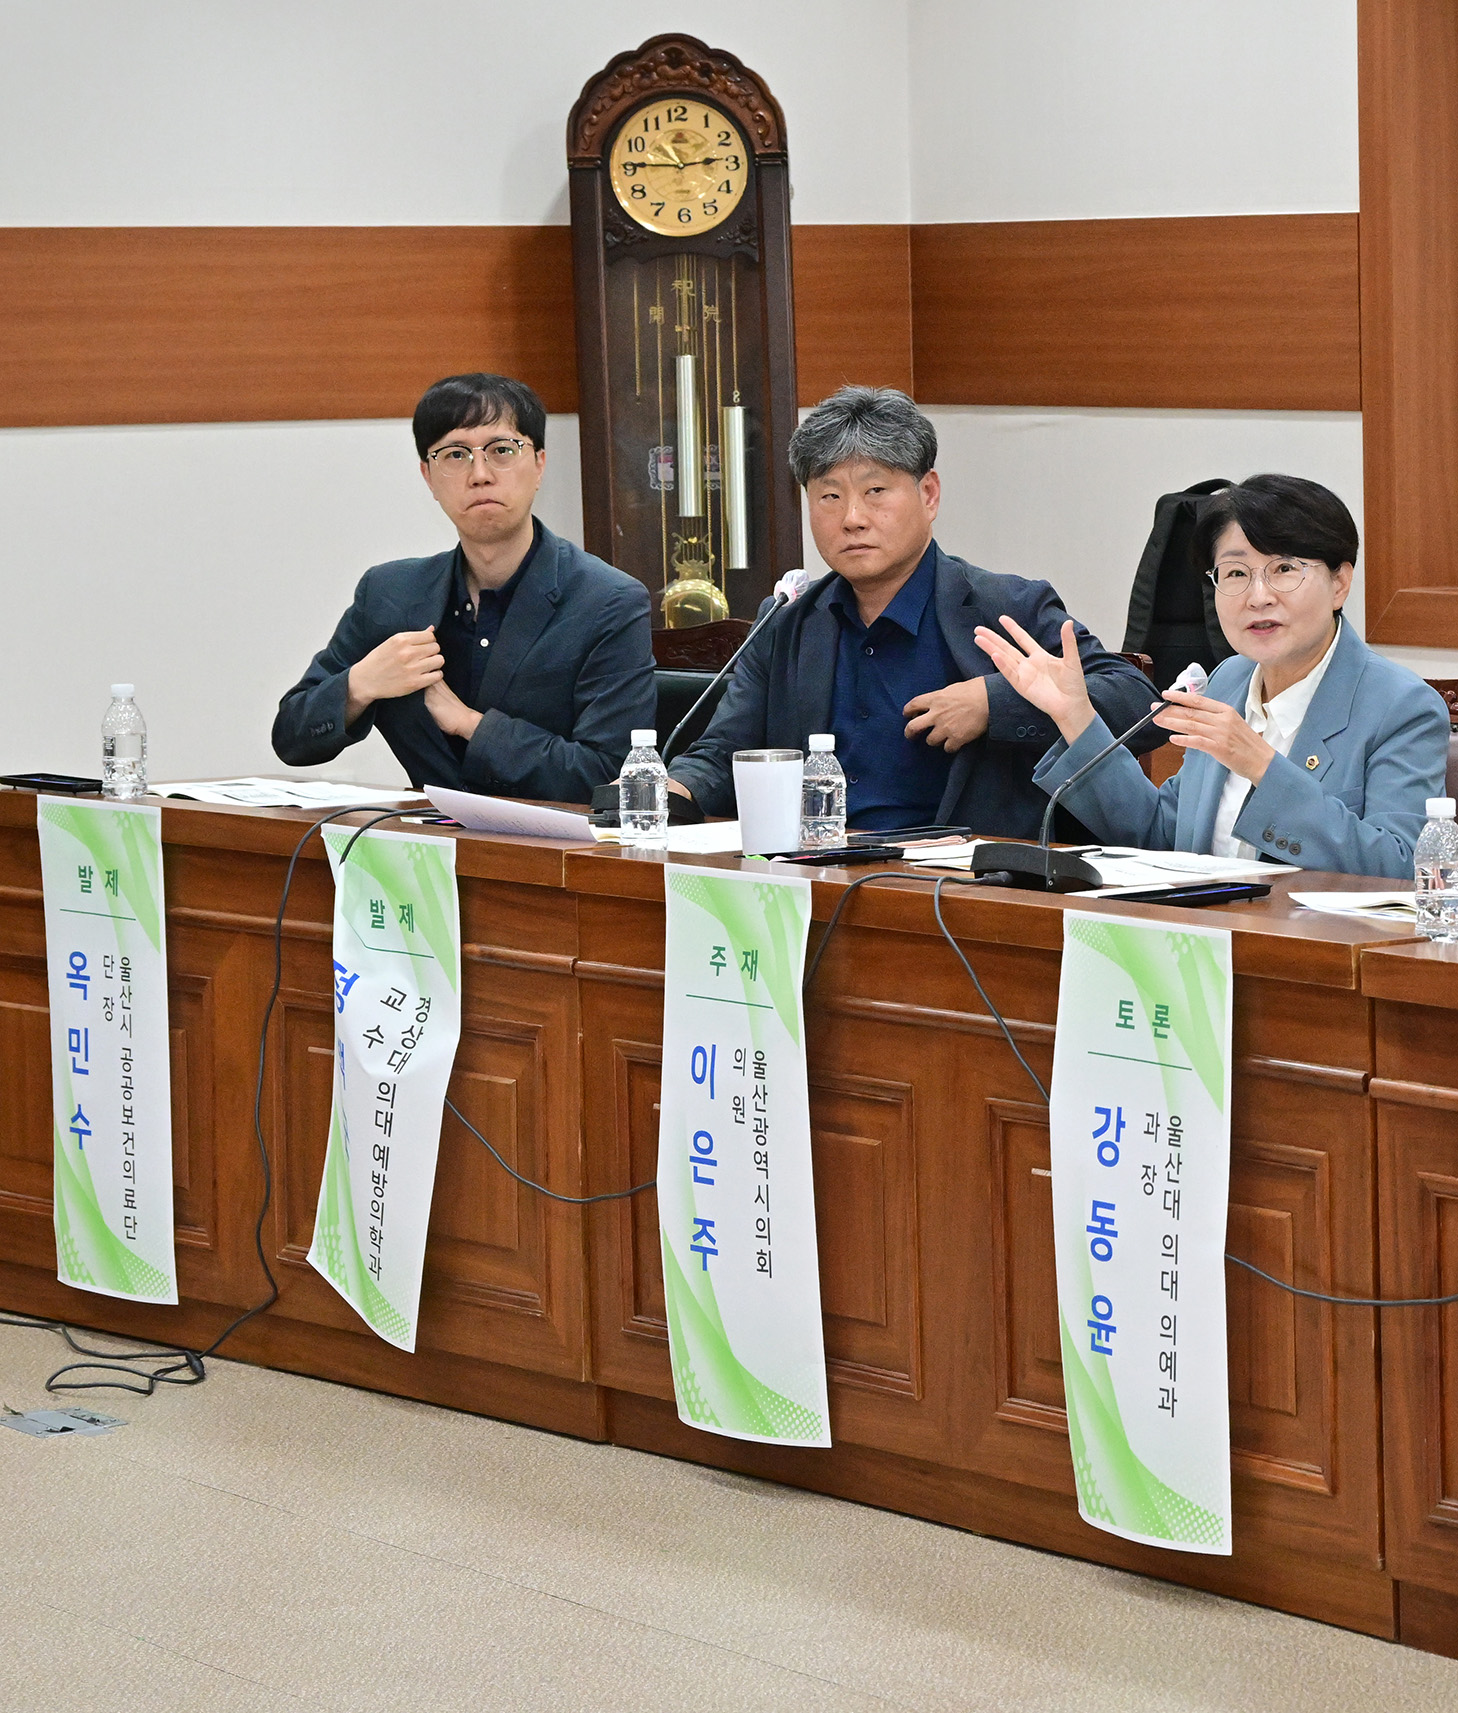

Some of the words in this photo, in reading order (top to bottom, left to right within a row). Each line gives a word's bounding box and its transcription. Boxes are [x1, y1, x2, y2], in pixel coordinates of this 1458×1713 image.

[643, 115, 660, 132] 11
[666, 105, 688, 123] 12
[703, 112, 710, 128] 1
[627, 136, 645, 152] 10
[717, 131, 732, 146] 2
[623, 161, 638, 176] 9
[725, 155, 740, 171] 3
[631, 184, 647, 199] 8
[717, 179, 733, 194] 4
[650, 202, 665, 216] 7
[677, 208, 692, 223] 6
[702, 199, 719, 215] 5
[77, 865, 119, 897] 발제
[369, 898, 415, 934] 발제
[709, 945, 759, 982] 주재
[119, 956, 133, 1039] 울산시
[385, 995, 432, 1076] 경상대
[1115, 999, 1171, 1040] 토론
[66, 951, 92, 1151] 옥민수
[374, 1081, 397, 1138] 의대
[120, 1047, 138, 1241] 공공보건의료단
[689, 1043, 719, 1272] 이은주
[752, 1050, 773, 1279] 울산광역시의회
[1163, 1115, 1184, 1221] 울산대
[368, 1143, 390, 1282] 예방의학과
[1086, 1106, 1126, 1357] 강동윤
[1160, 1234, 1179, 1302] 의대
[1157, 1315, 1178, 1418] 의예과
